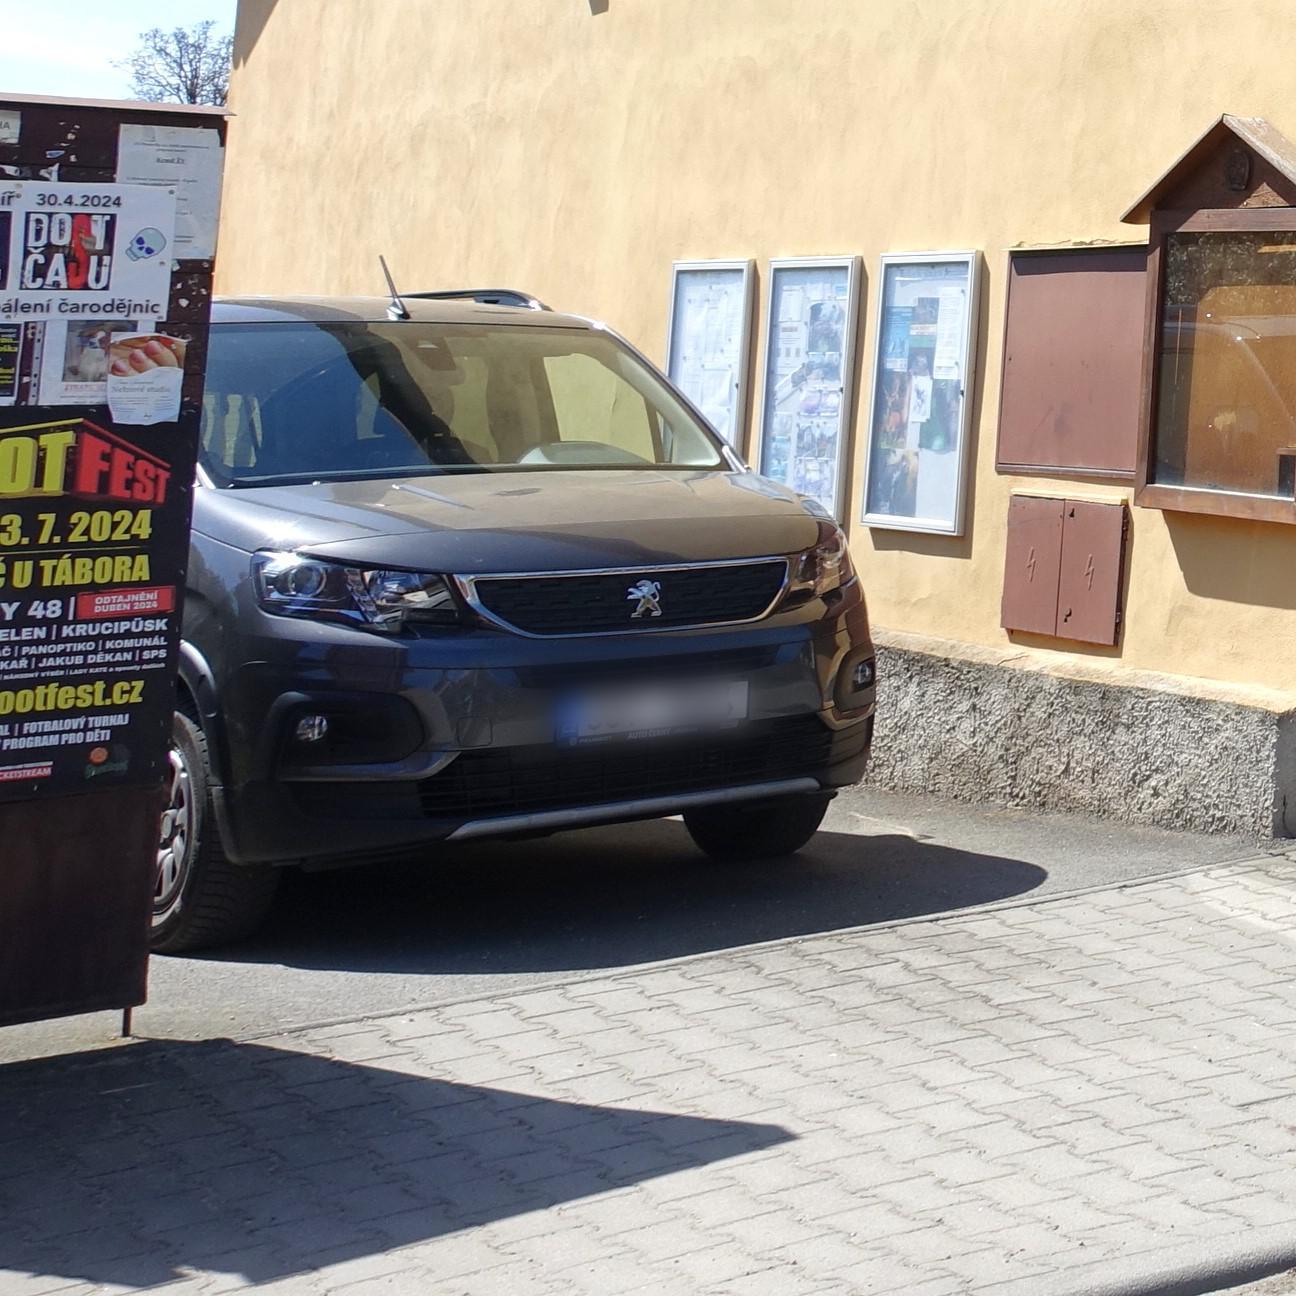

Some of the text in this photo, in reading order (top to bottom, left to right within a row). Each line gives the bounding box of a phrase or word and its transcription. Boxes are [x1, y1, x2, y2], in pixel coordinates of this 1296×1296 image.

[36, 193, 122, 208] 30.4.2024
[0, 298, 161, 317] álení čarodějnic
[38, 512, 61, 544] 7.
[68, 509, 152, 543] 2024
[12, 560, 34, 588] U
[39, 554, 150, 587] TÁBORA
[28, 599, 63, 619] 48
[94, 602, 131, 613] DUBEN
[22, 640, 95, 655] PANOPTIKO
[105, 636, 168, 650] KOMUNÁL
[38, 655, 84, 668] JAKUB
[87, 650, 133, 664] DĚKAN
[142, 649, 168, 660] SPS
[23, 716, 86, 735] FOTBALOVÝ
[88, 713, 130, 727] TURNAJ
[2, 729, 111, 751] PROGRAM PRO DĚTI
